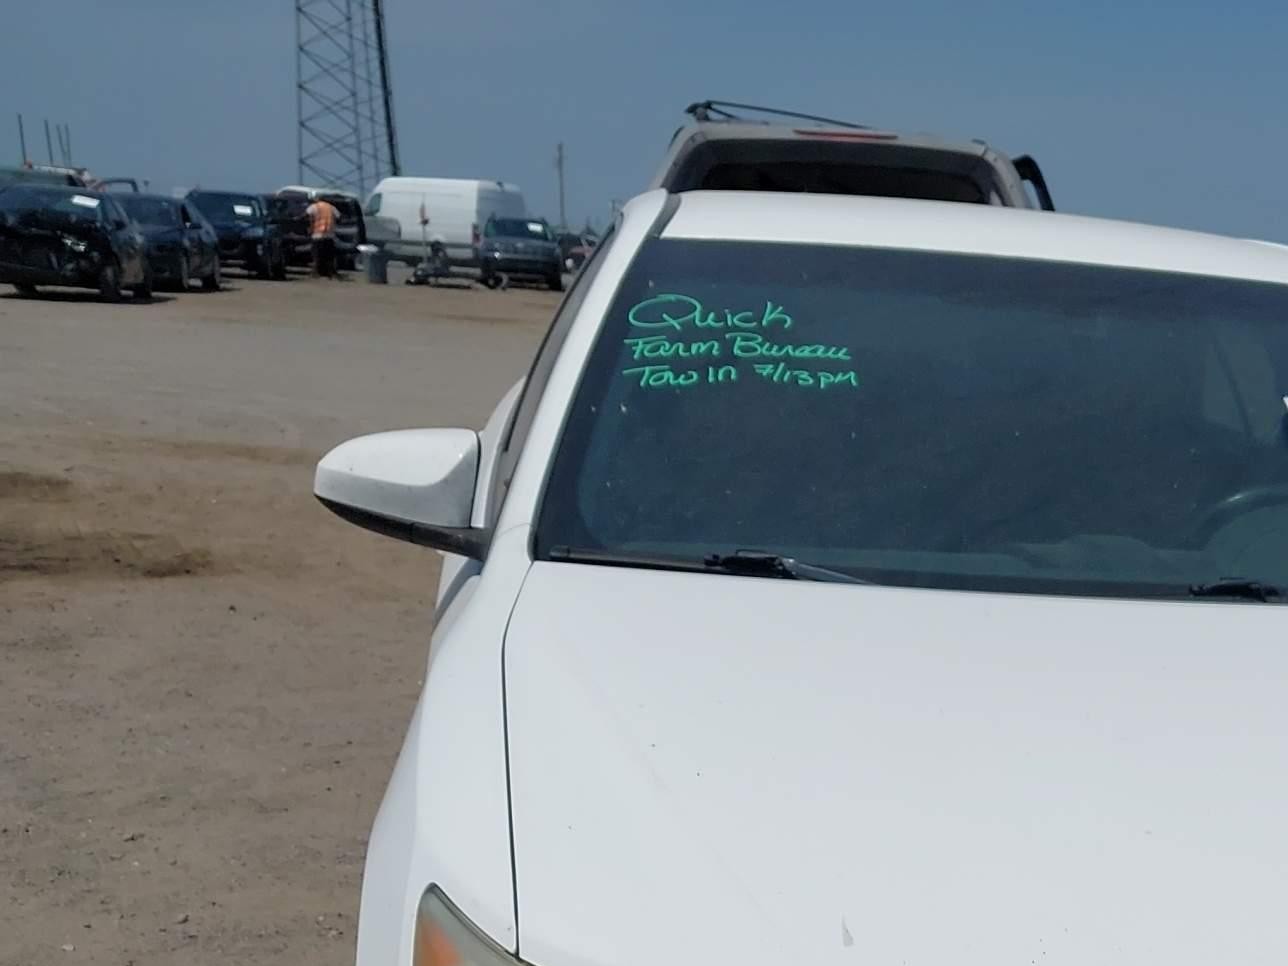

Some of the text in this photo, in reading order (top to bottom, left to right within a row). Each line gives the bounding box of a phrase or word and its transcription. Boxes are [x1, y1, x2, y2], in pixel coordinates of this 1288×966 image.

[628, 293, 793, 330] Quick
[623, 331, 852, 361] Farm Bureau
[622, 364, 700, 388] Tow
